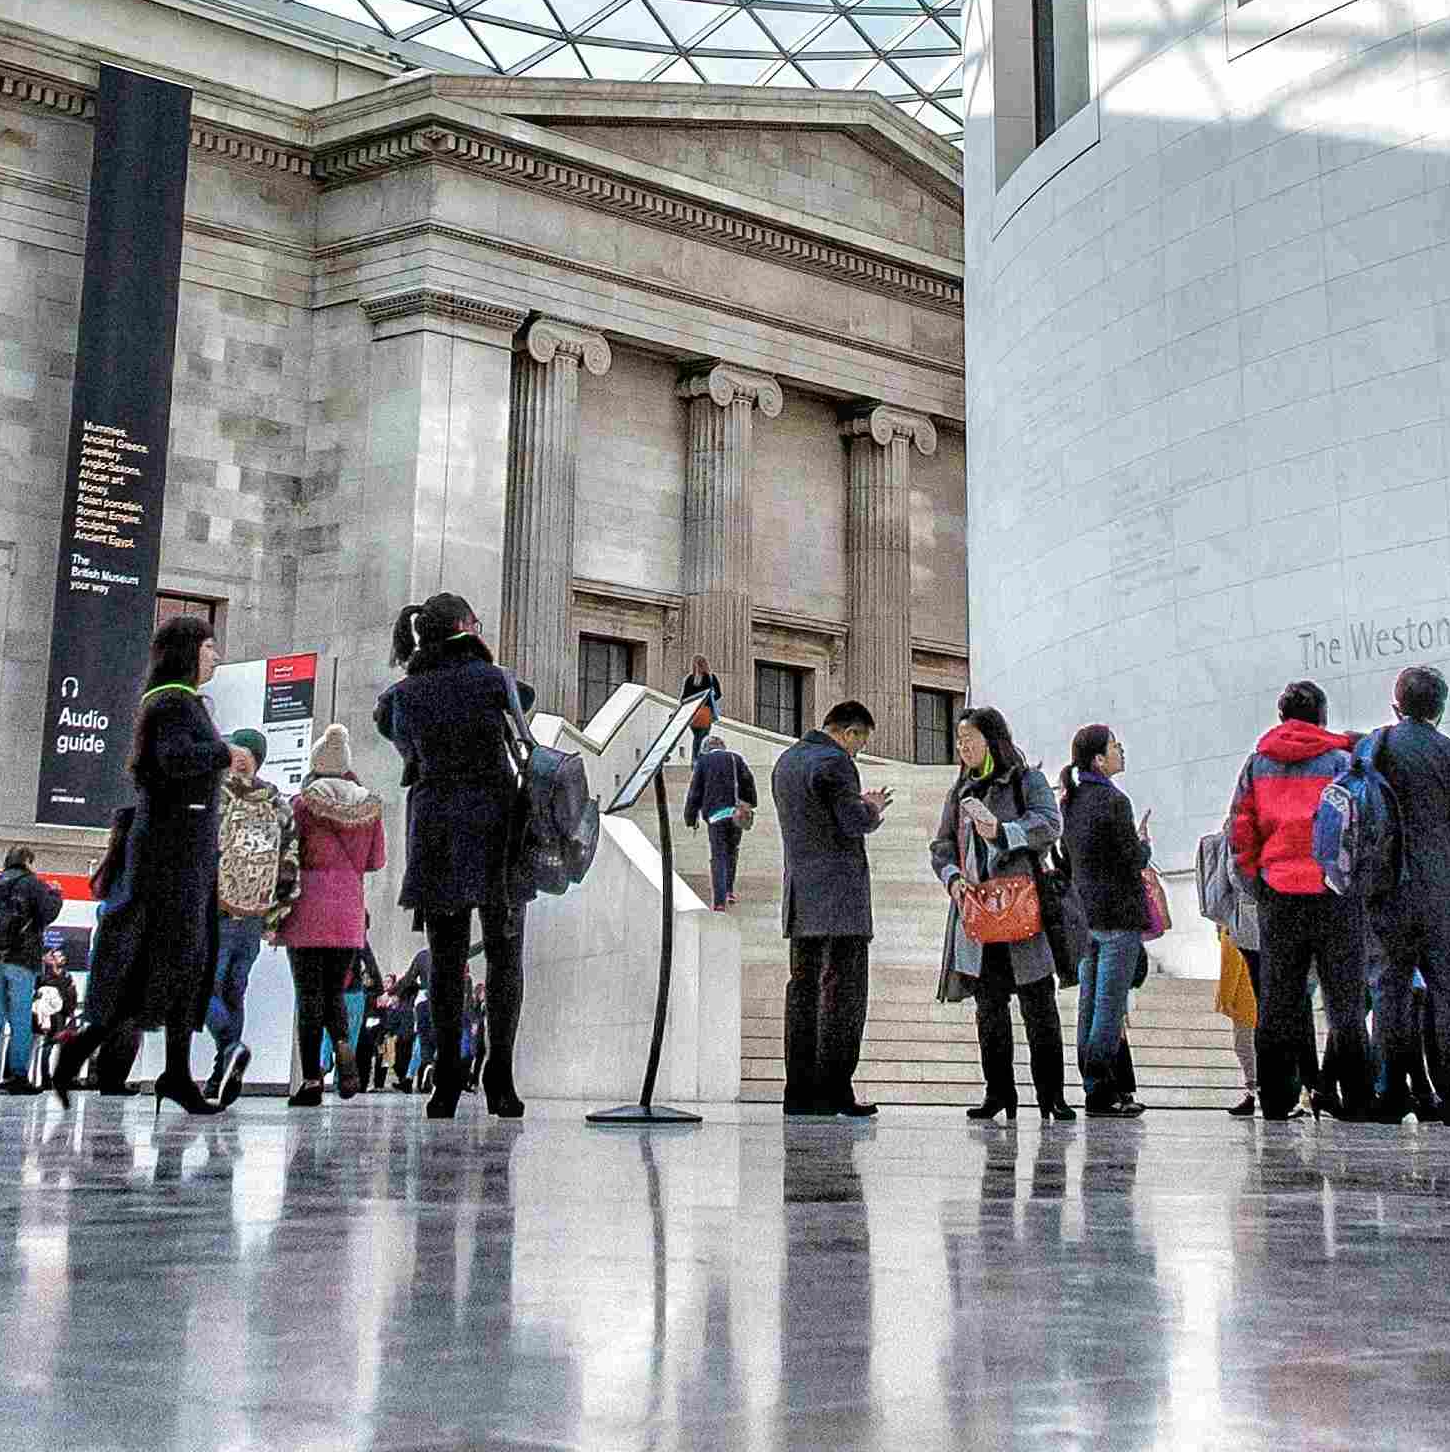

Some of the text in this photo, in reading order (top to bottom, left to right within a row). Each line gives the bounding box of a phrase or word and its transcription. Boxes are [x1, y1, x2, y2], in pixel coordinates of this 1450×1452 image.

[72, 553, 91, 566] The
[70, 566, 139, 586] British Museum
[69, 580, 111, 596] your way
[1297, 630, 1342, 672] The
[58, 706, 109, 730] Audio
[56, 732, 106, 754] guide
